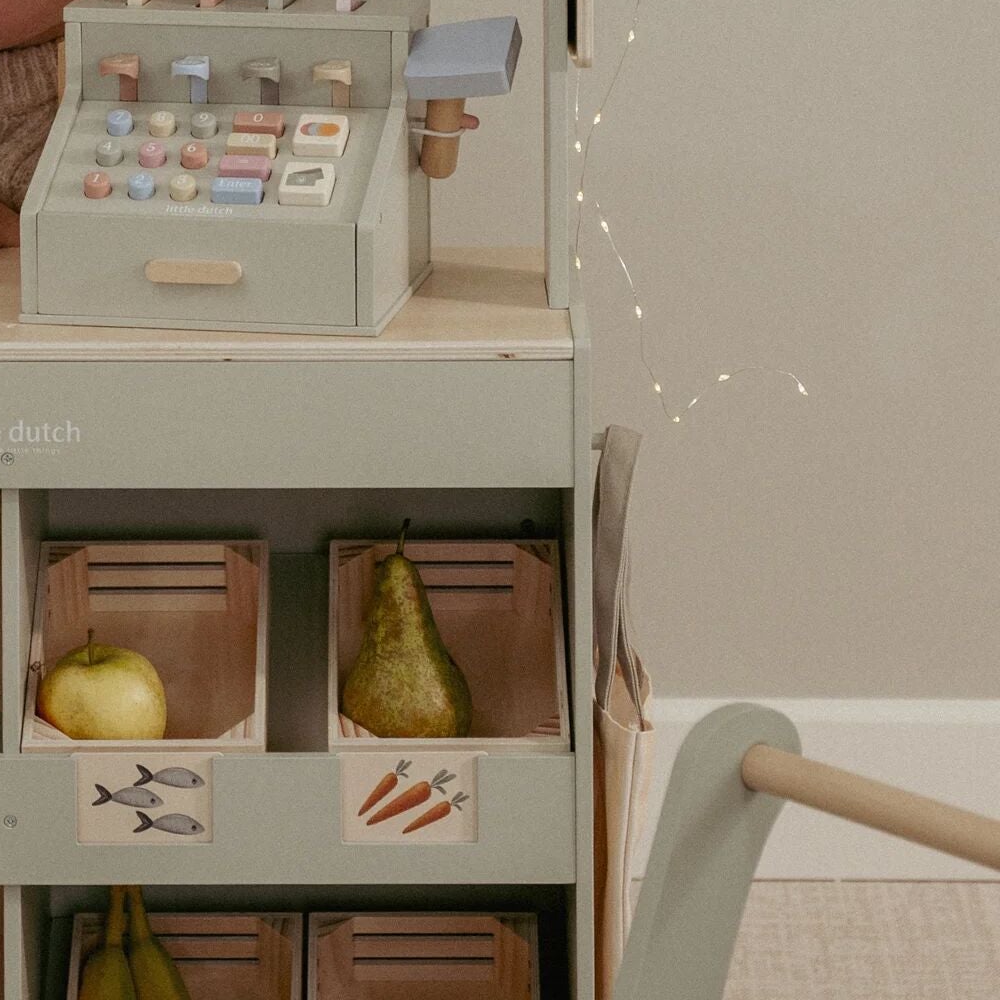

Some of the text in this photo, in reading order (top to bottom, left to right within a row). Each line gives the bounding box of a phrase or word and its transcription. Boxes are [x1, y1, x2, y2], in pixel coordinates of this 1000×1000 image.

[199, 113, 209, 122] 9
[253, 113, 264, 123] 0
[102, 142, 113, 151] 4
[146, 142, 157, 152] 5
[187, 144, 197, 153] 6
[92, 174, 100, 184] 1
[134, 174, 145, 184] 2
[177, 174, 188, 184] 3
[8, 419, 81, 443] dutch
